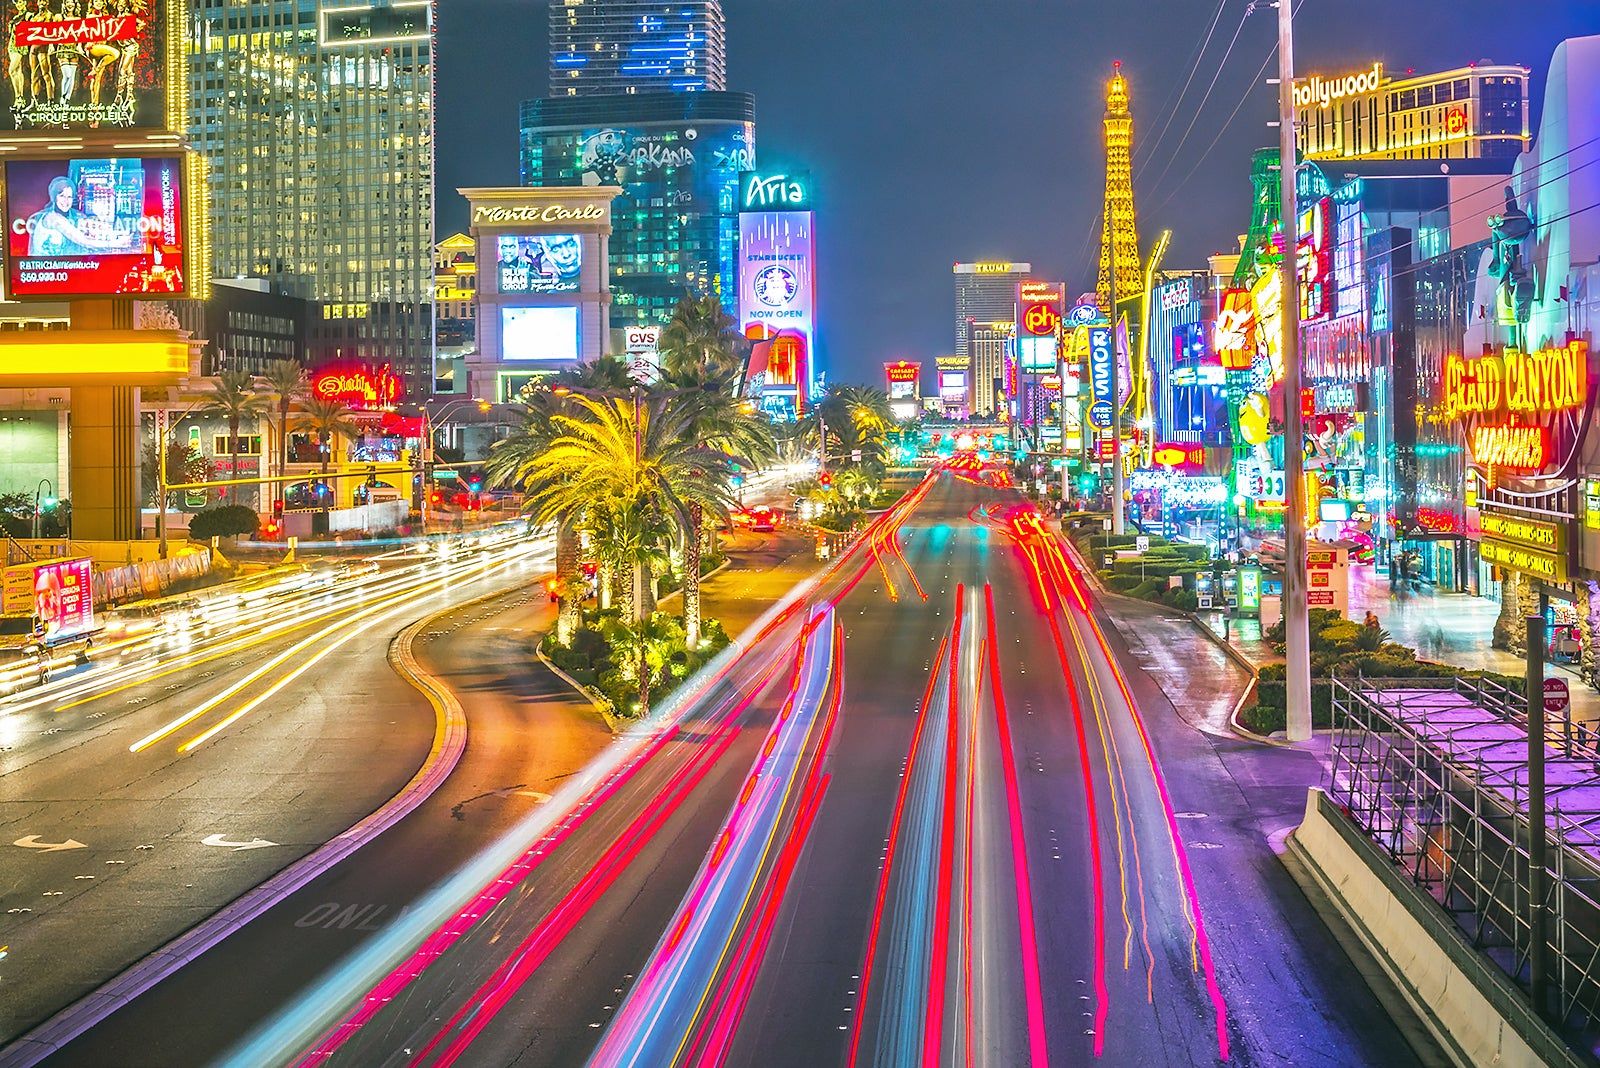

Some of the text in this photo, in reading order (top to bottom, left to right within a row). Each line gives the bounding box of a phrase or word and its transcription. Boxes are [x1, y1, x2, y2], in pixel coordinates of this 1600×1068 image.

[26, 18, 126, 42] ZUMANITY
[1292, 64, 1380, 108] hollywood
[29, 112, 125, 124] CIRQUE DU SOLEIL
[745, 174, 803, 207] Aria
[474, 204, 605, 222] Monte Carlo
[748, 254, 802, 262] STARBUCKS
[976, 263, 1011, 273] TRUMP
[1022, 283, 1046, 292] planet
[1022, 293, 1058, 302] hollywood
[750, 310, 803, 318] NOW OPEN
[1029, 306, 1055, 331] ph
[629, 333, 655, 343] CVS
[1093, 330, 1109, 396] ROSS
[1505, 341, 1580, 412] CANYON
